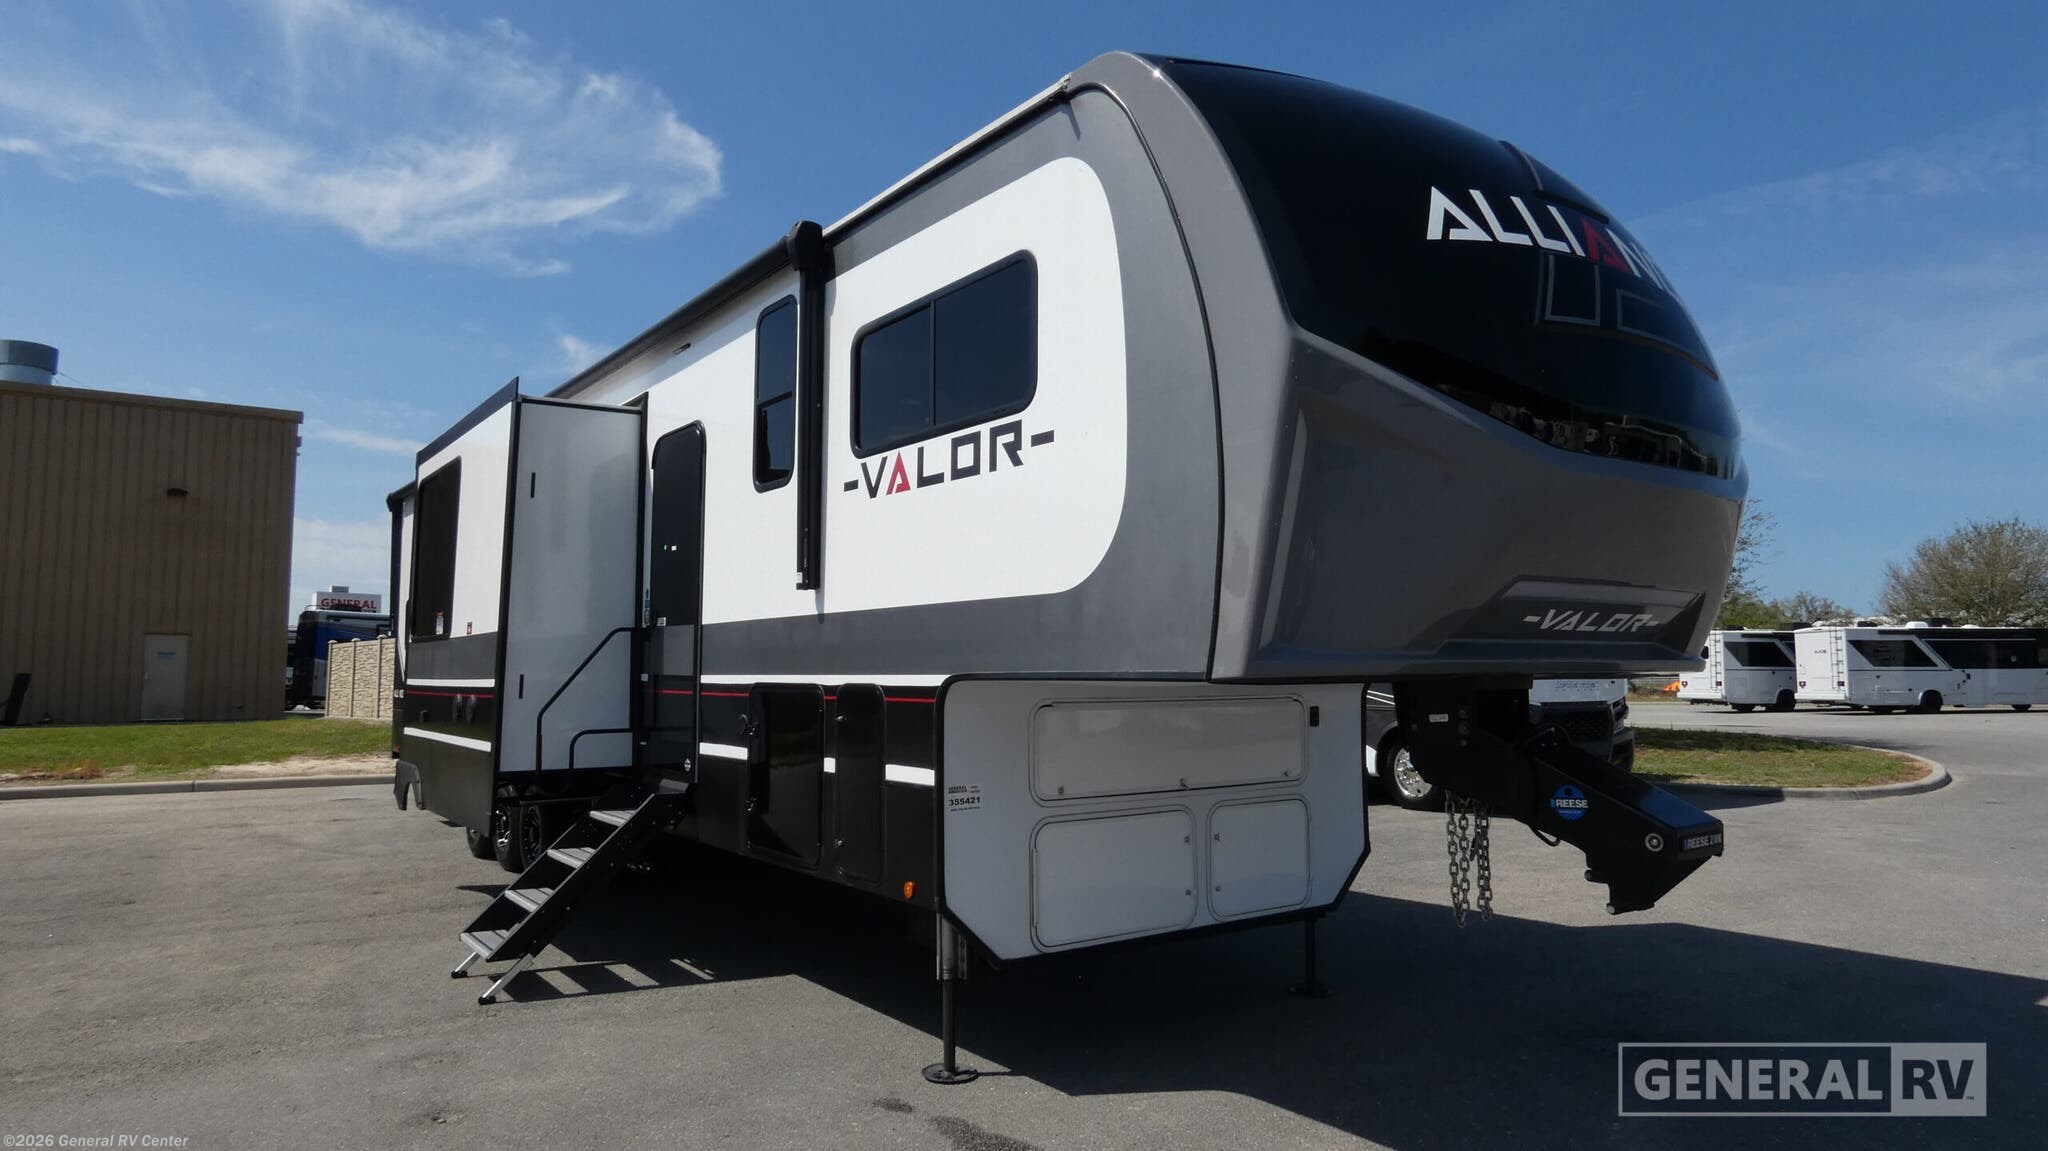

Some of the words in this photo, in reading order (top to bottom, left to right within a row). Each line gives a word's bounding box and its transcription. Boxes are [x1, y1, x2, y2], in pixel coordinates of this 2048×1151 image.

[1426, 185, 1680, 302] ALLIAN
[320, 598, 377, 609] GENERAL
[948, 796, 981, 807] 355421
[1555, 798, 1589, 808] REESE
[1687, 835, 1709, 849] REESE
